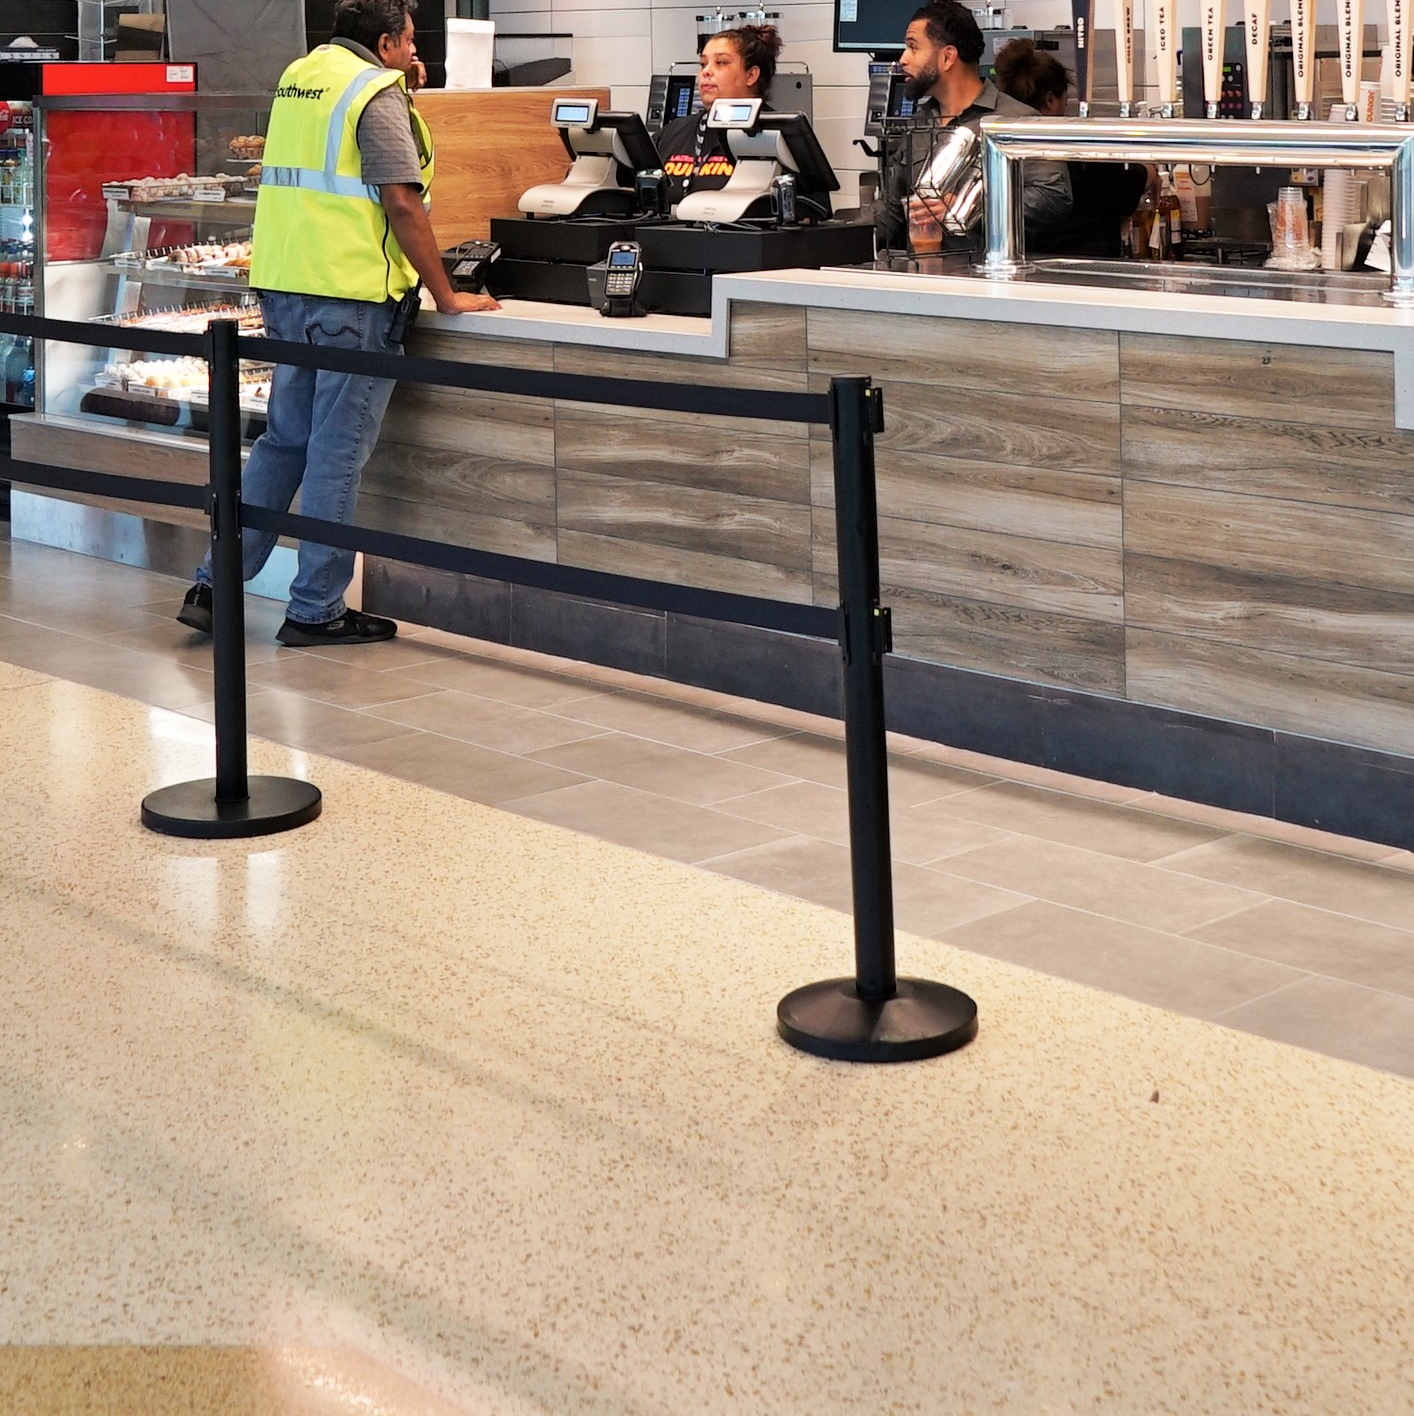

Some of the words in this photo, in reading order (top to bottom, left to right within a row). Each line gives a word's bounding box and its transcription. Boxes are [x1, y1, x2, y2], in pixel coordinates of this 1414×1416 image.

[1077, 16, 1085, 49] NITRO
[12, 116, 23, 124] ICE
[23, 116, 33, 124] CO
